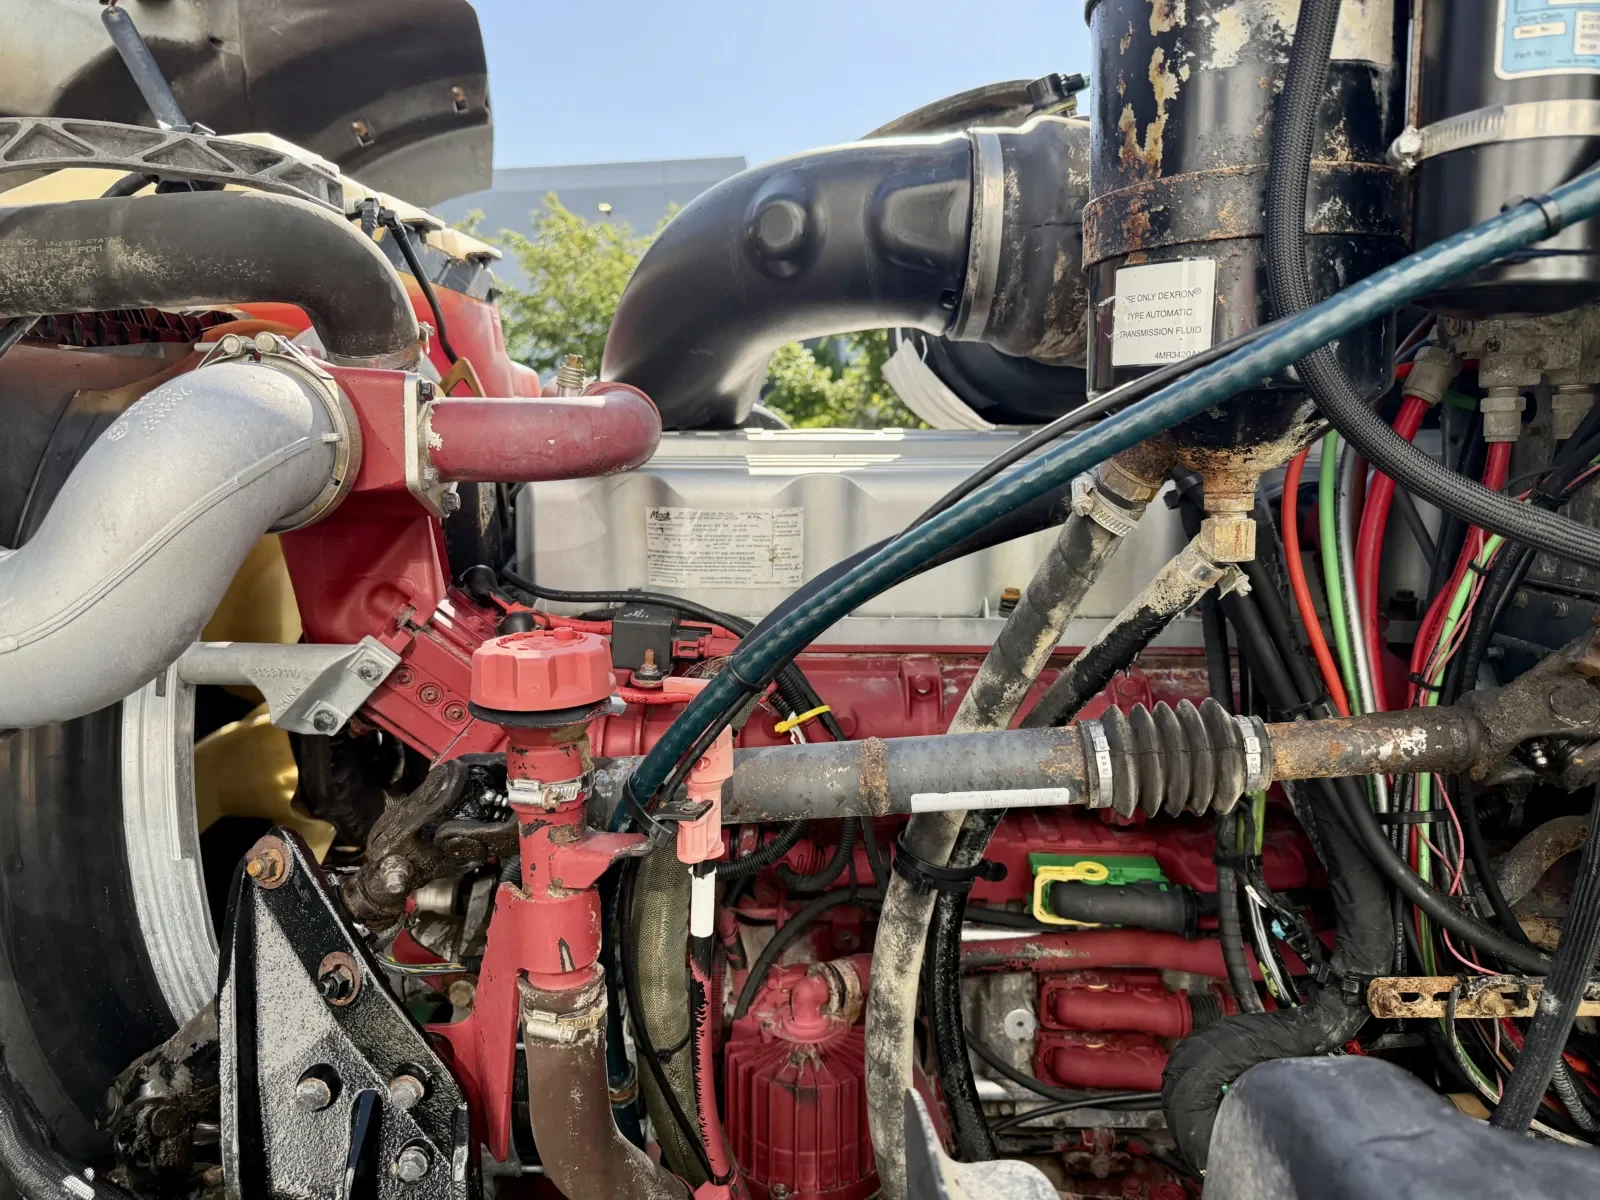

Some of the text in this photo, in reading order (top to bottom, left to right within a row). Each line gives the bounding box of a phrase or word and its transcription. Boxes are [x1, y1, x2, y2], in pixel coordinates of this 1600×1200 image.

[45, 239, 81, 248] UNITED
[69, 244, 103, 255] EPDM
[1126, 294, 1136, 304] SE
[1137, 292, 1157, 303] ONLY
[1128, 307, 1193, 321] TYPE AUTOMATIC
[1119, 325, 1202, 340] TRANSMISSION FLUID
[1154, 349, 1201, 360] 4MR3420A
[650, 510, 671, 521] Mack
[275, 684, 304, 712] CHINA
